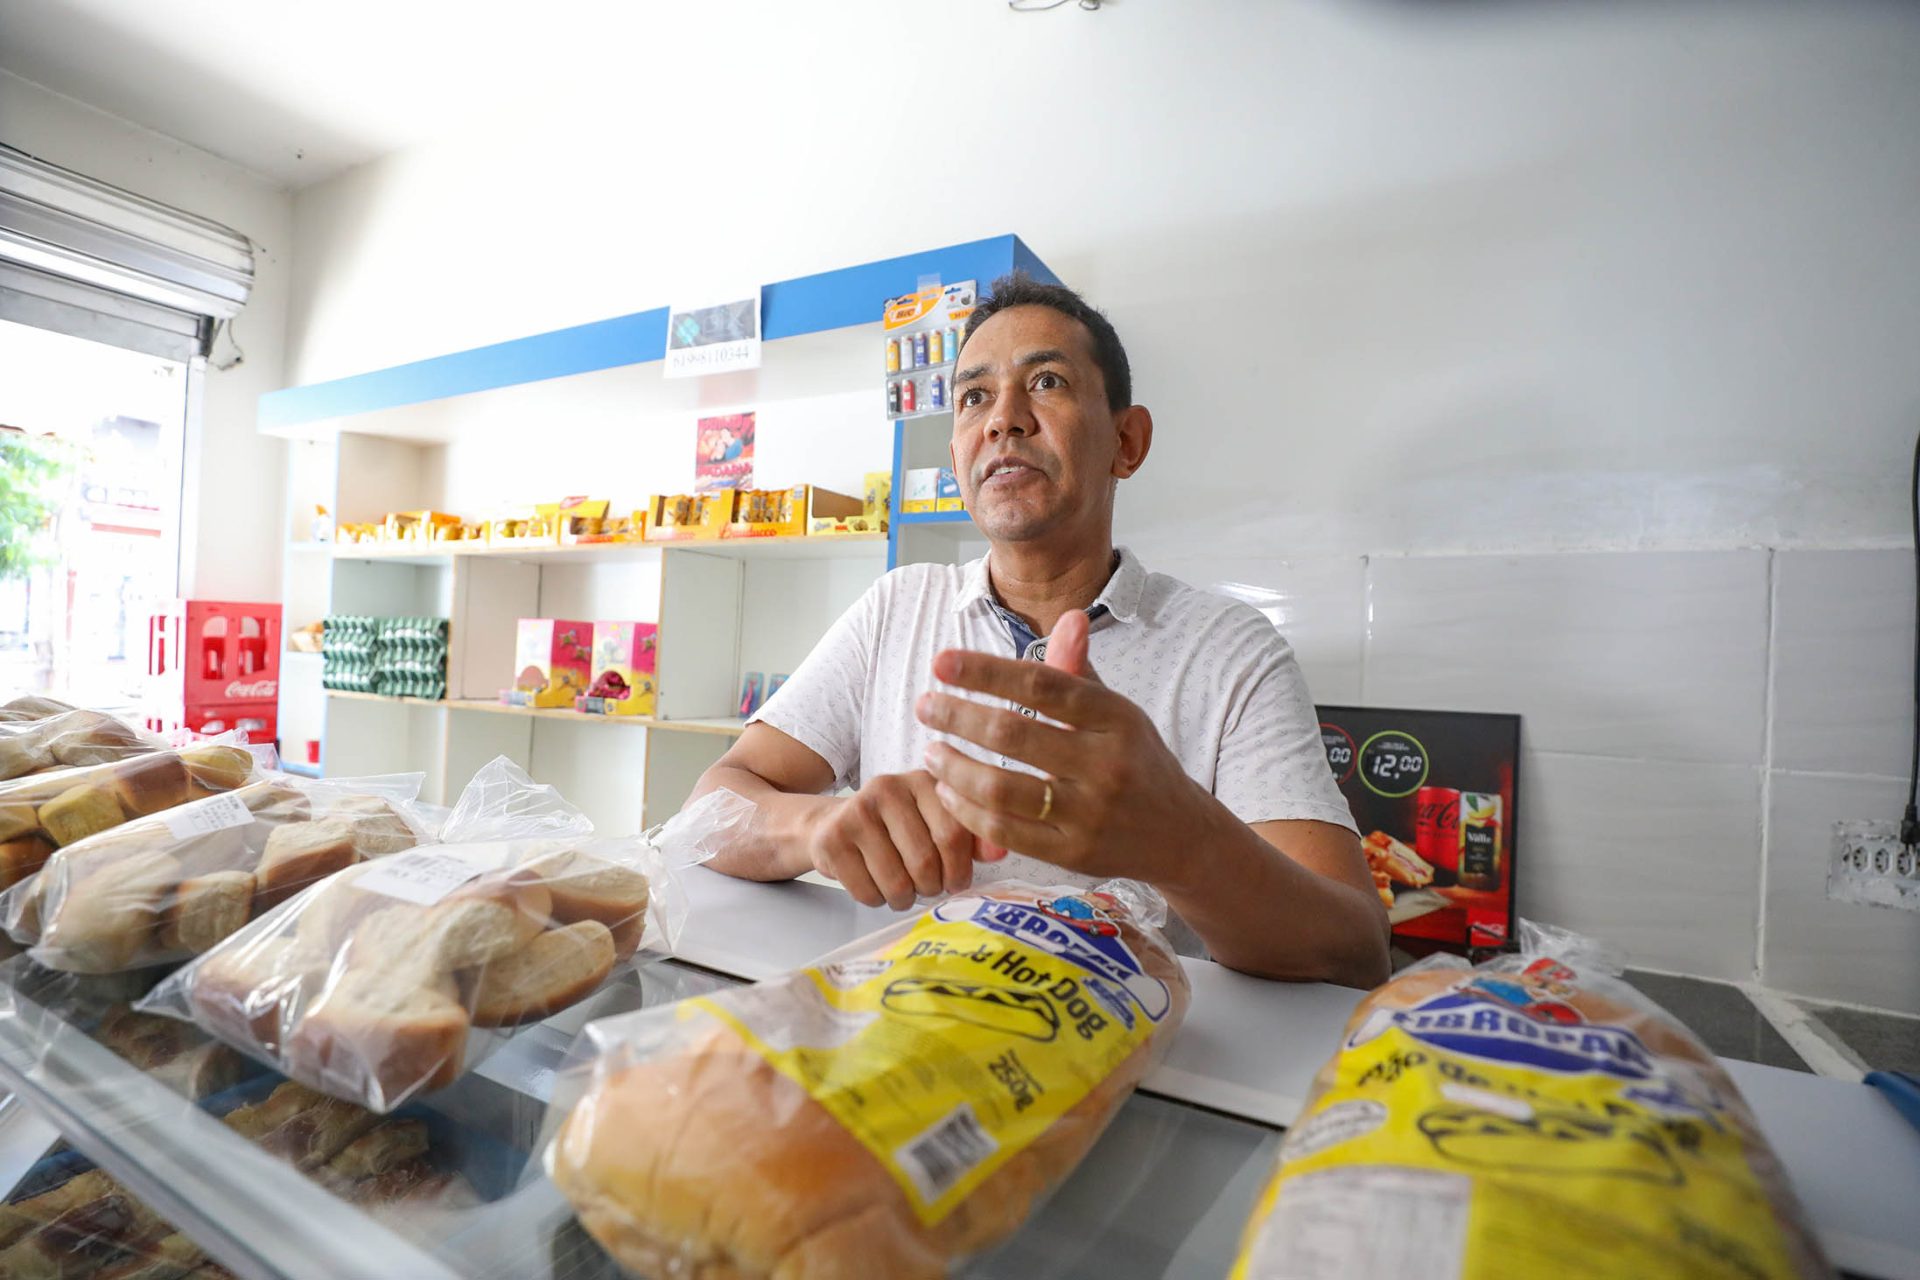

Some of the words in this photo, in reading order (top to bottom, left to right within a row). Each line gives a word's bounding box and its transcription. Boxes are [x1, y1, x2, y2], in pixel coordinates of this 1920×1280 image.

[896, 308, 916, 319] BIC
[991, 950, 1051, 986] Hot
[1048, 978, 1108, 1040] Dog
